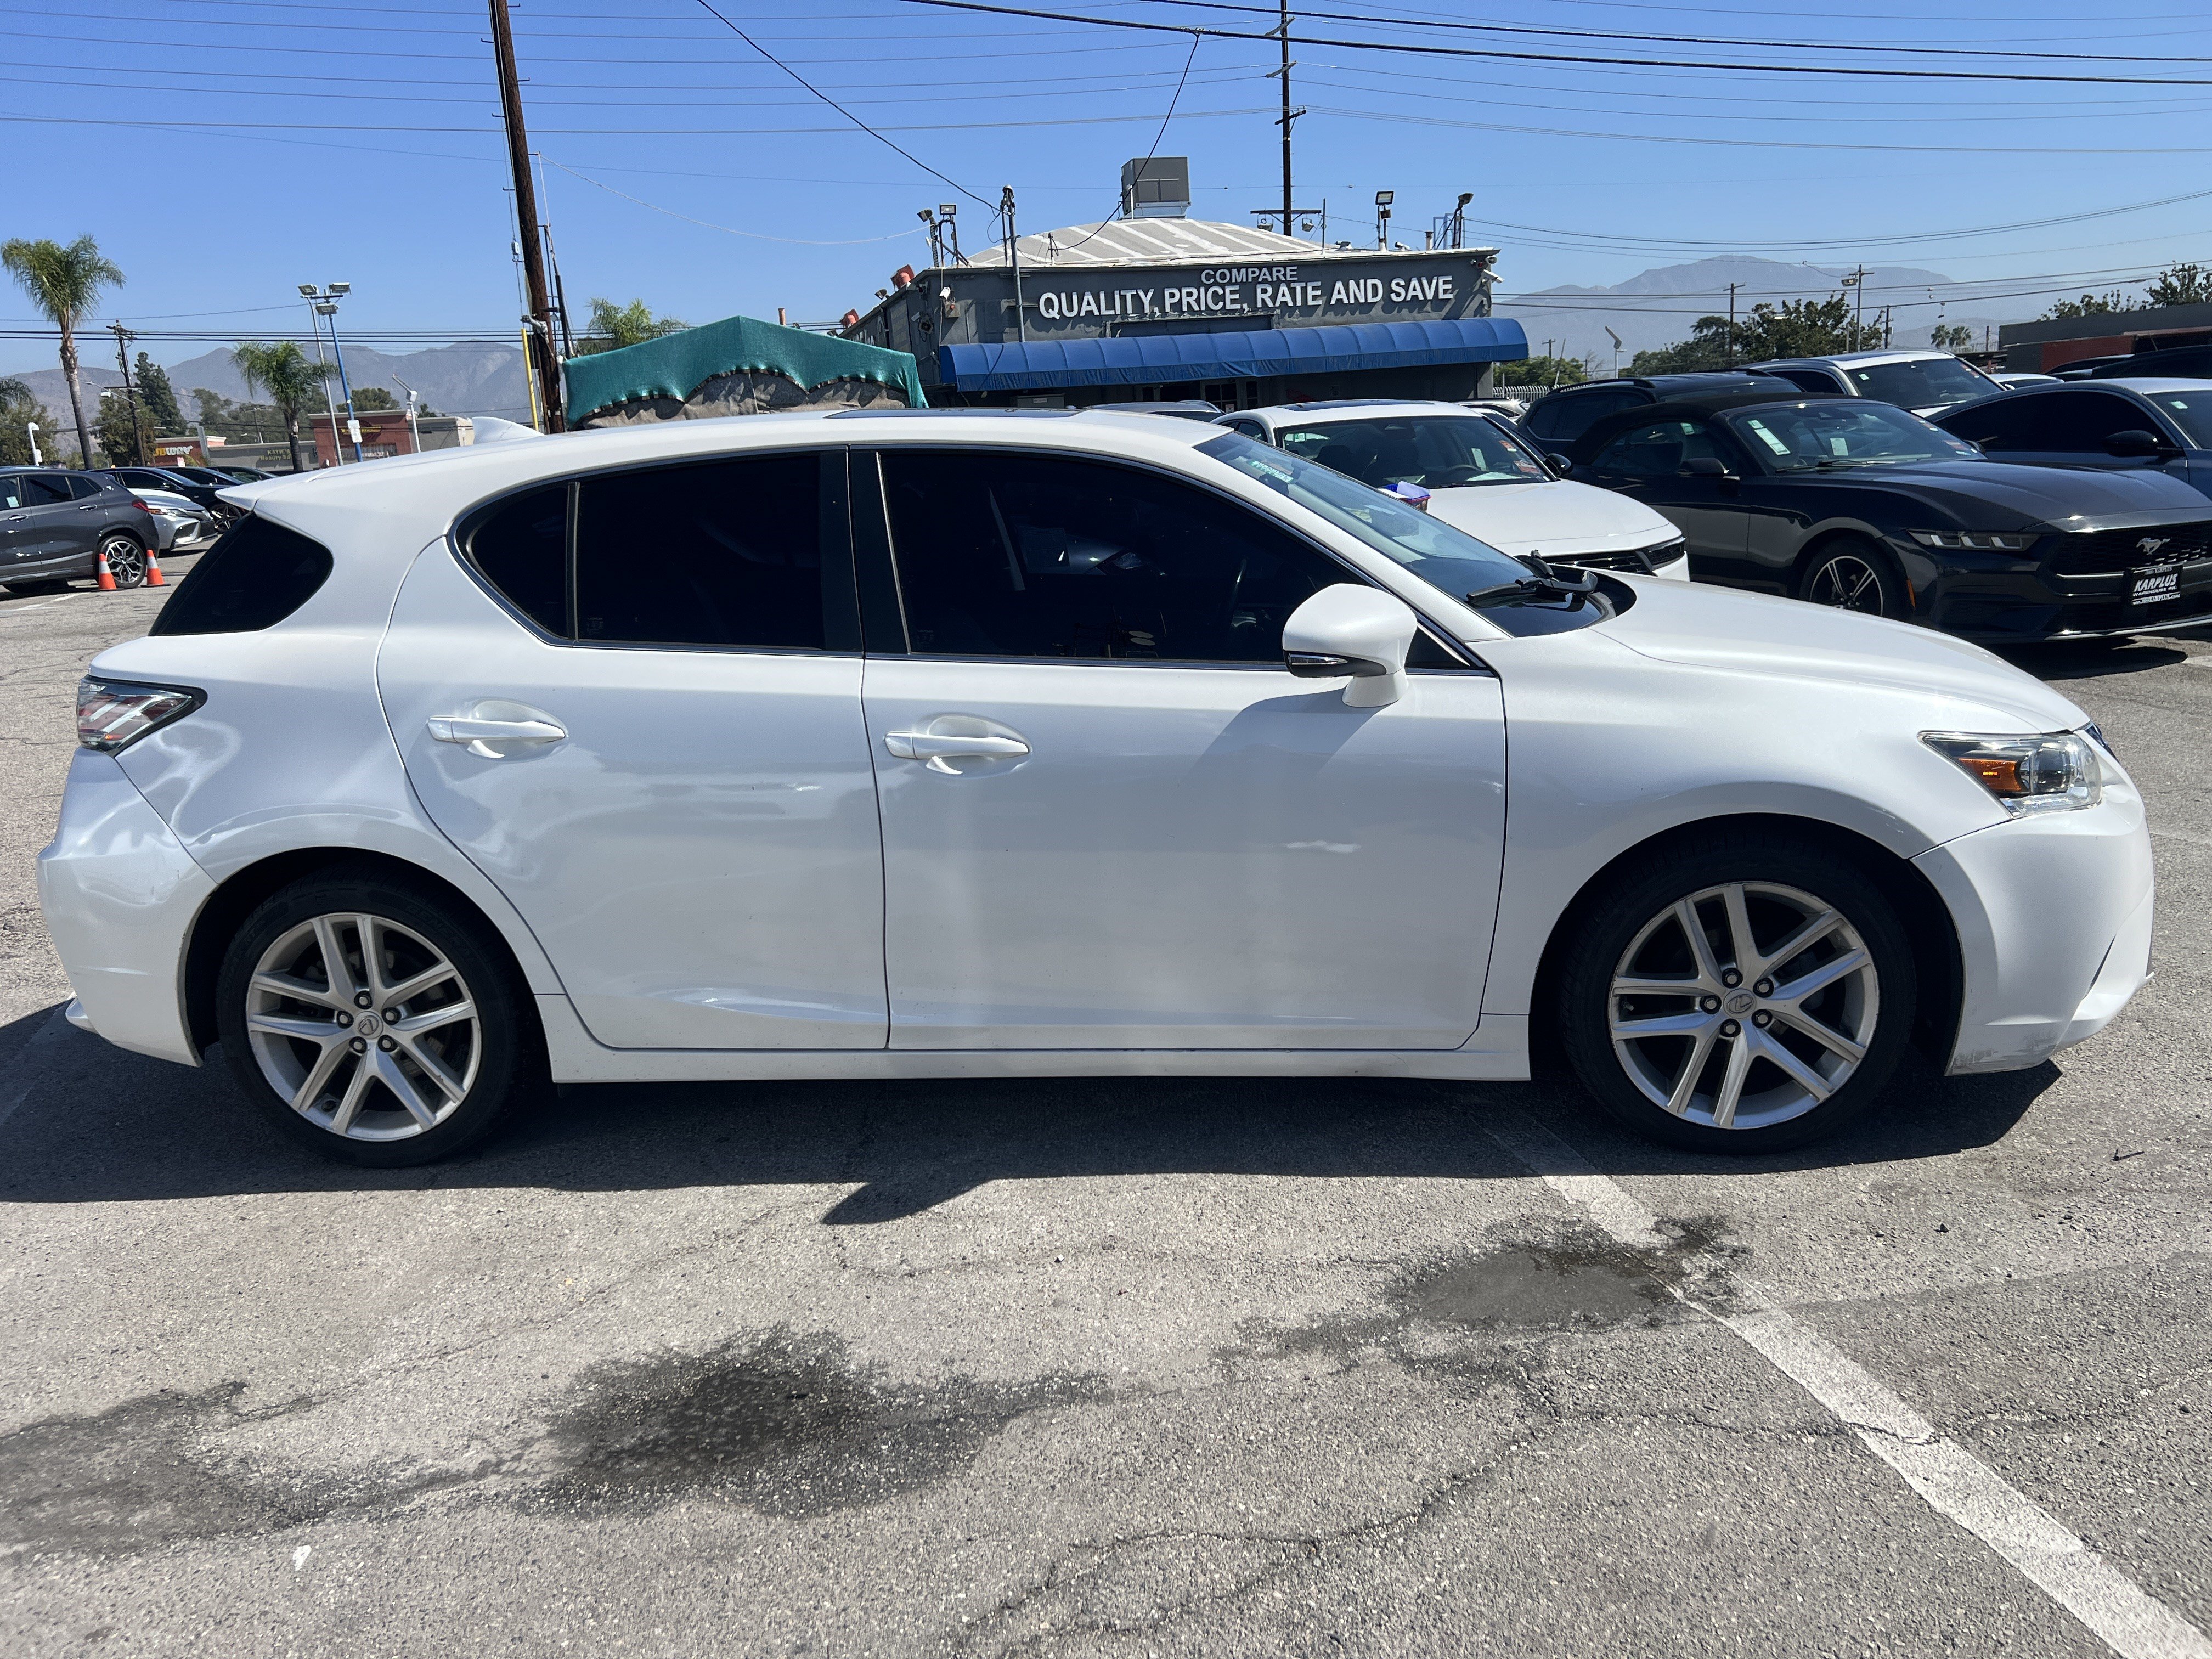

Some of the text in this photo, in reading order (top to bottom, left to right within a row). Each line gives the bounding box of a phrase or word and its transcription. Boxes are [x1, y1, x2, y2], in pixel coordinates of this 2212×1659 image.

[1201, 266, 1298, 284] COMPARE
[1039, 275, 1453, 319] QUALITY, PRICE, RATE AND SAVE
[153, 445, 193, 456] UBWAY
[2133, 588, 2166, 596] WAREHOUSE
[2134, 574, 2178, 592] KARPLUS
